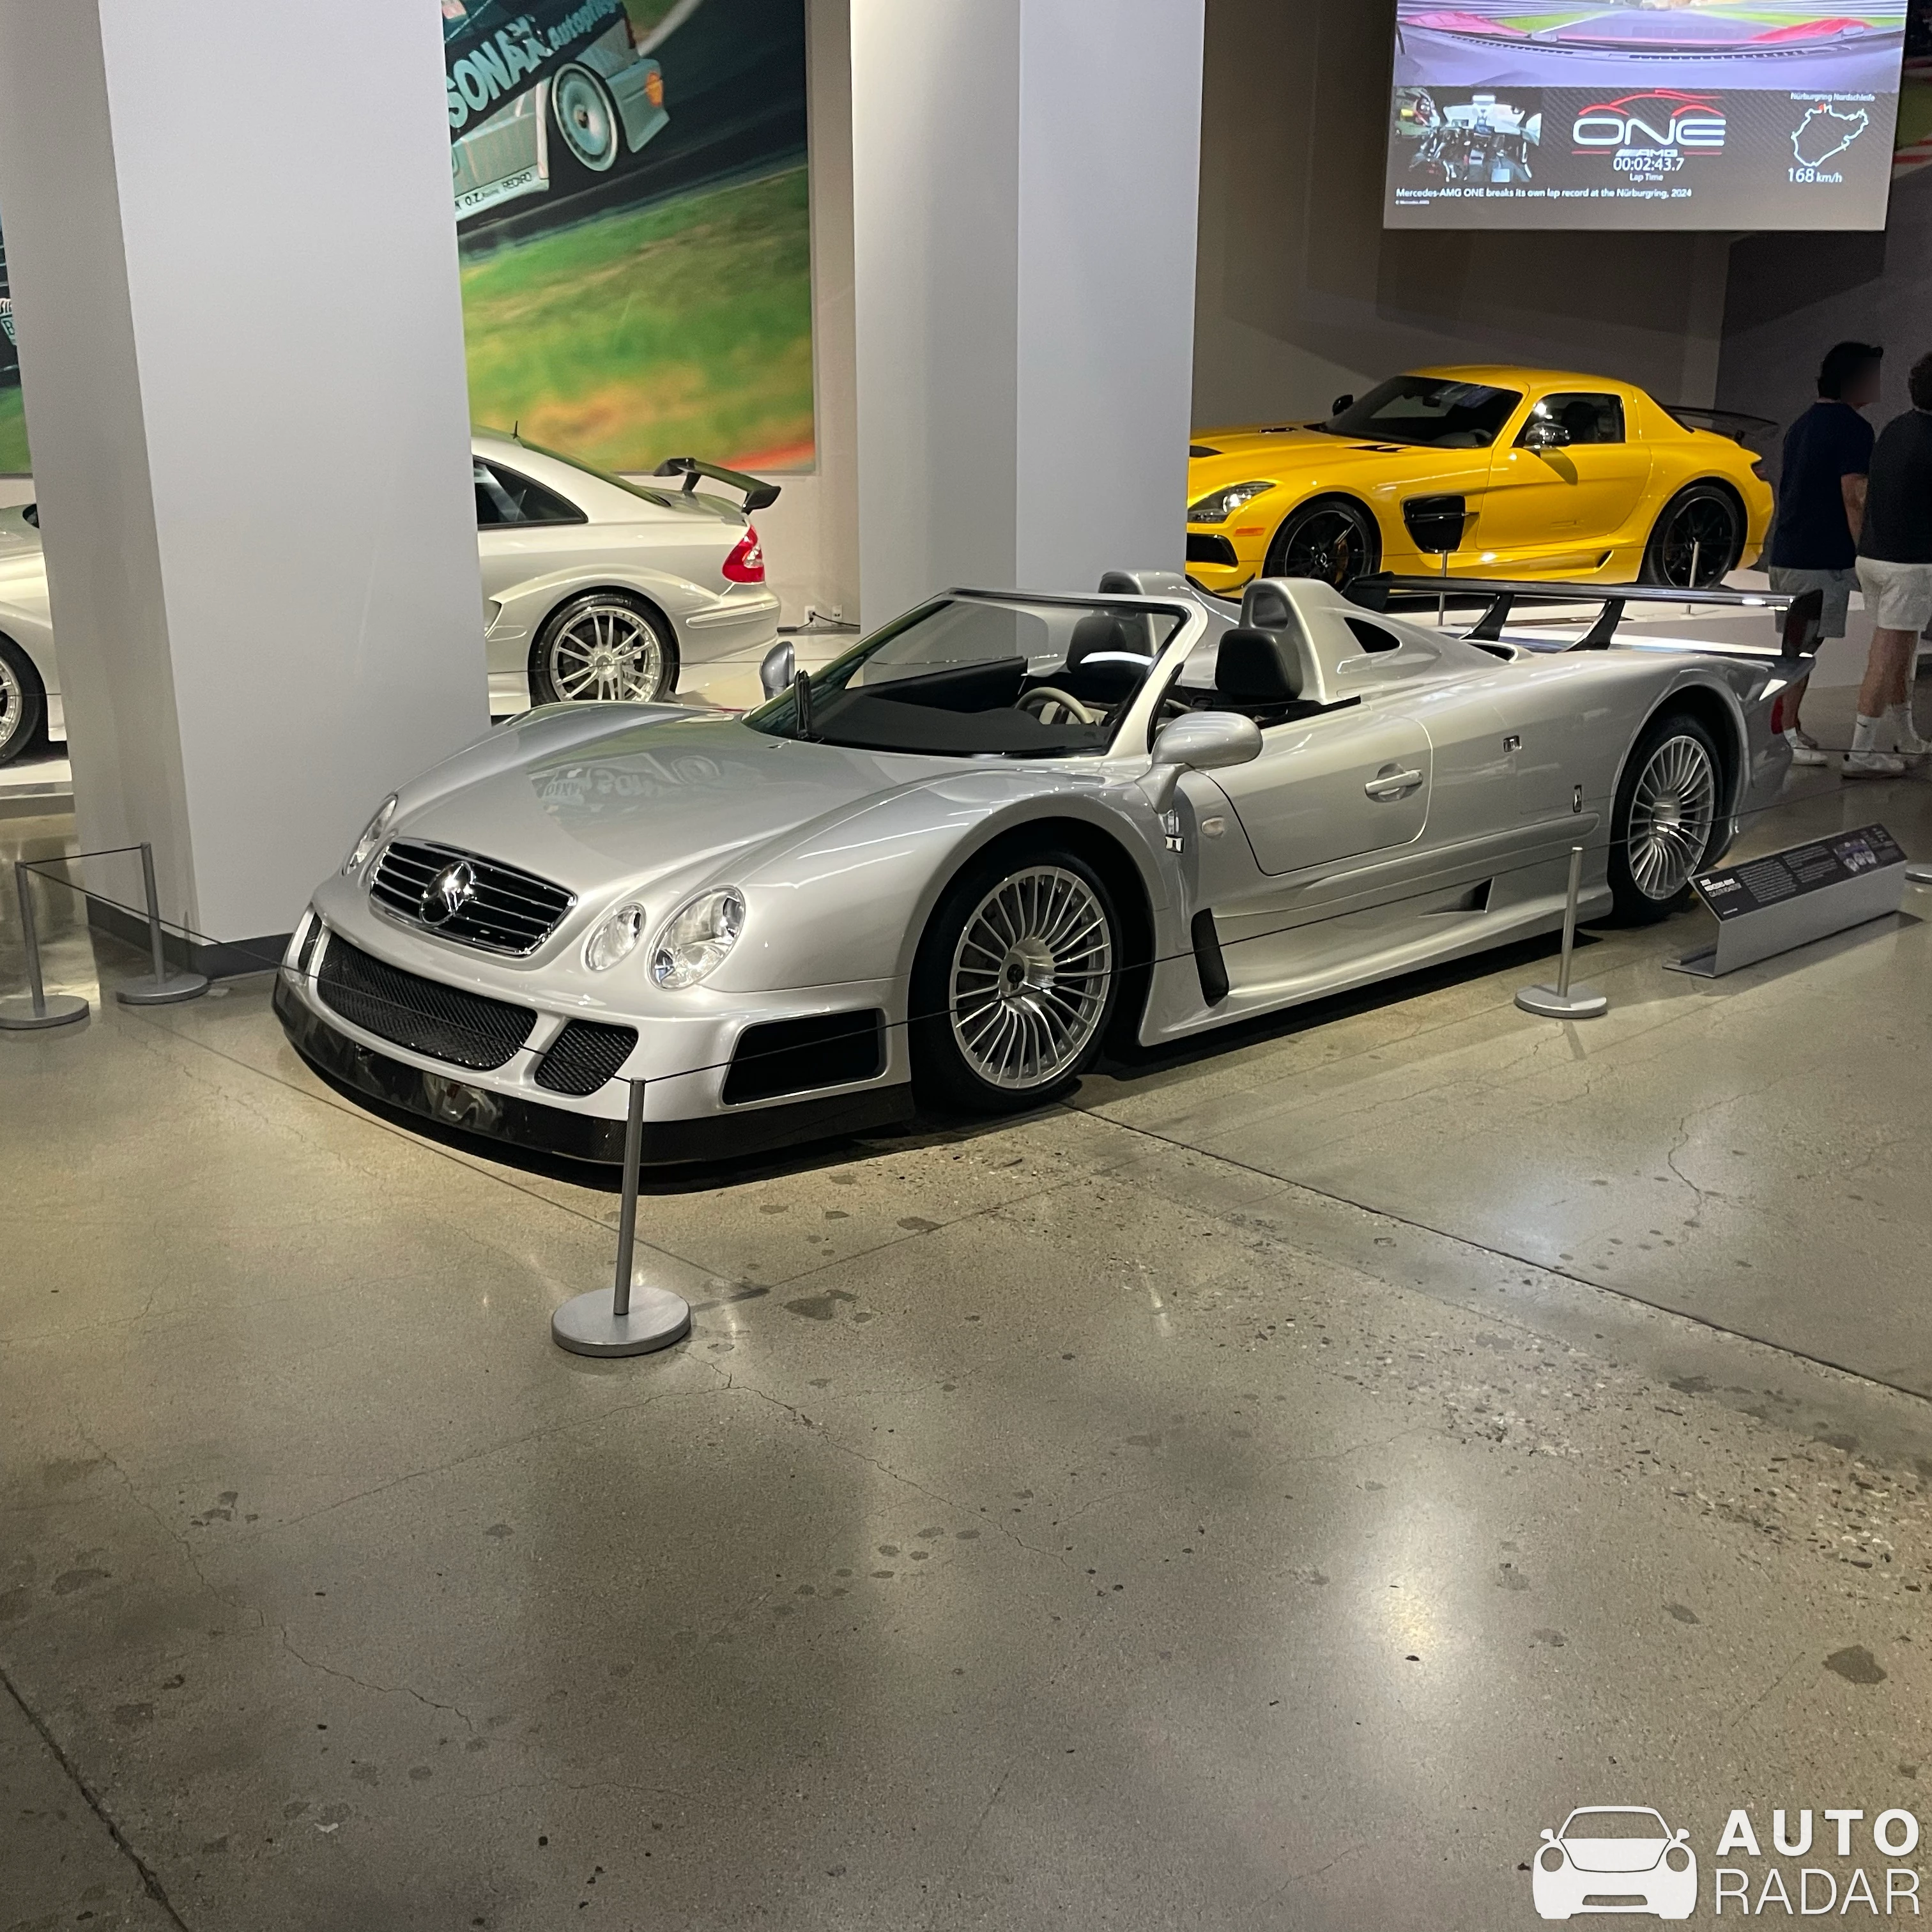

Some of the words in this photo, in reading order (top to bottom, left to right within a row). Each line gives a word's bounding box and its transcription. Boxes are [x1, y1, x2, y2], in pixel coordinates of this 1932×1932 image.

[1573, 118, 1726, 146] ONE
[1613, 157, 1684, 171] 00:02:43.7
[1629, 173, 1644, 182] Lap
[1788, 167, 1814, 183] 168
[1816, 172, 1842, 183] km/h
[1396, 188, 1462, 197] Mercedes-AMG
[1464, 188, 1484, 197] ONE
[1486, 188, 1514, 197] breaks
[1515, 188, 1525, 197] its
[1547, 188, 1562, 199] lap
[1562, 188, 1589, 197] record
[1601, 188, 1614, 197] the
[1617, 188, 1669, 199] Nürburgring,
[1671, 188, 1692, 197] 2024
